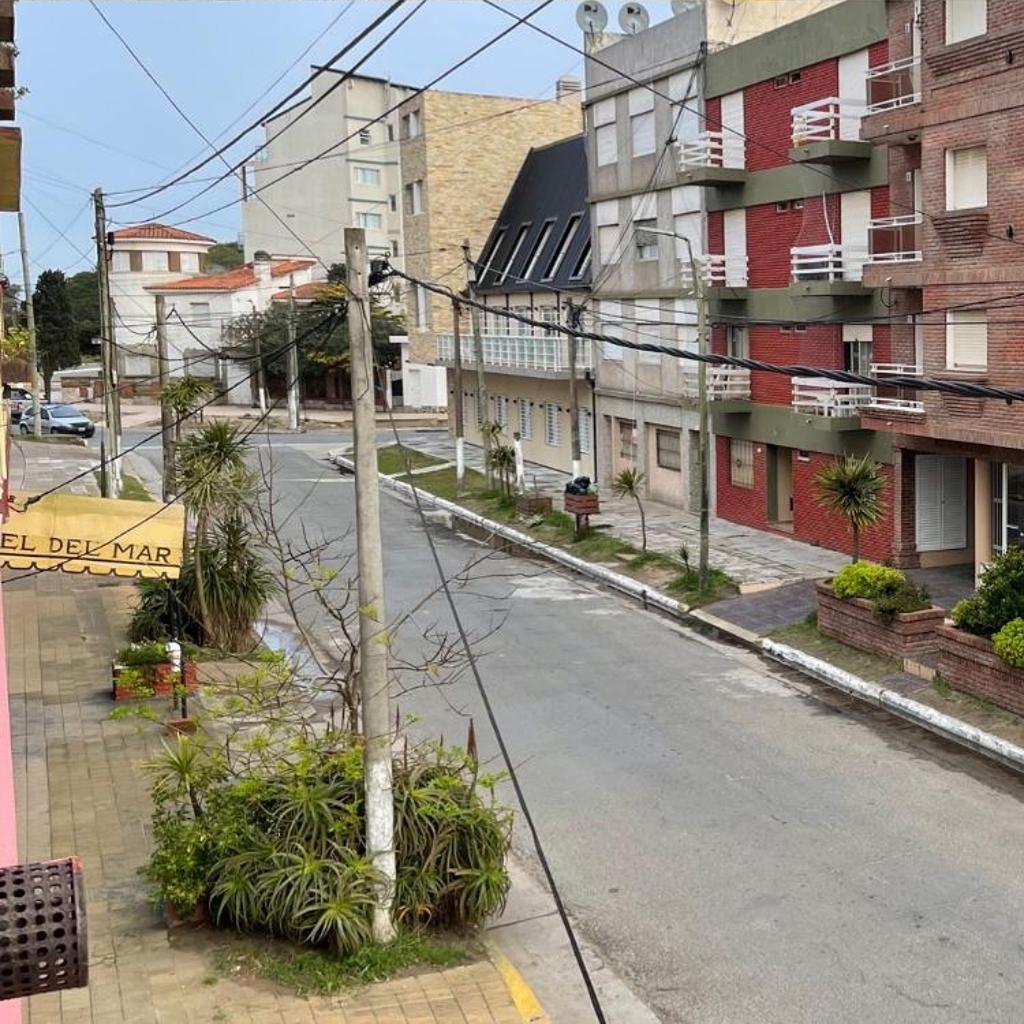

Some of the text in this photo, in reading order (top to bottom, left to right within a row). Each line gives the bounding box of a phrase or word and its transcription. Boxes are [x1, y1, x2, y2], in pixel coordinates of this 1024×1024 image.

[1, 533, 171, 563] EL DEL MAR
